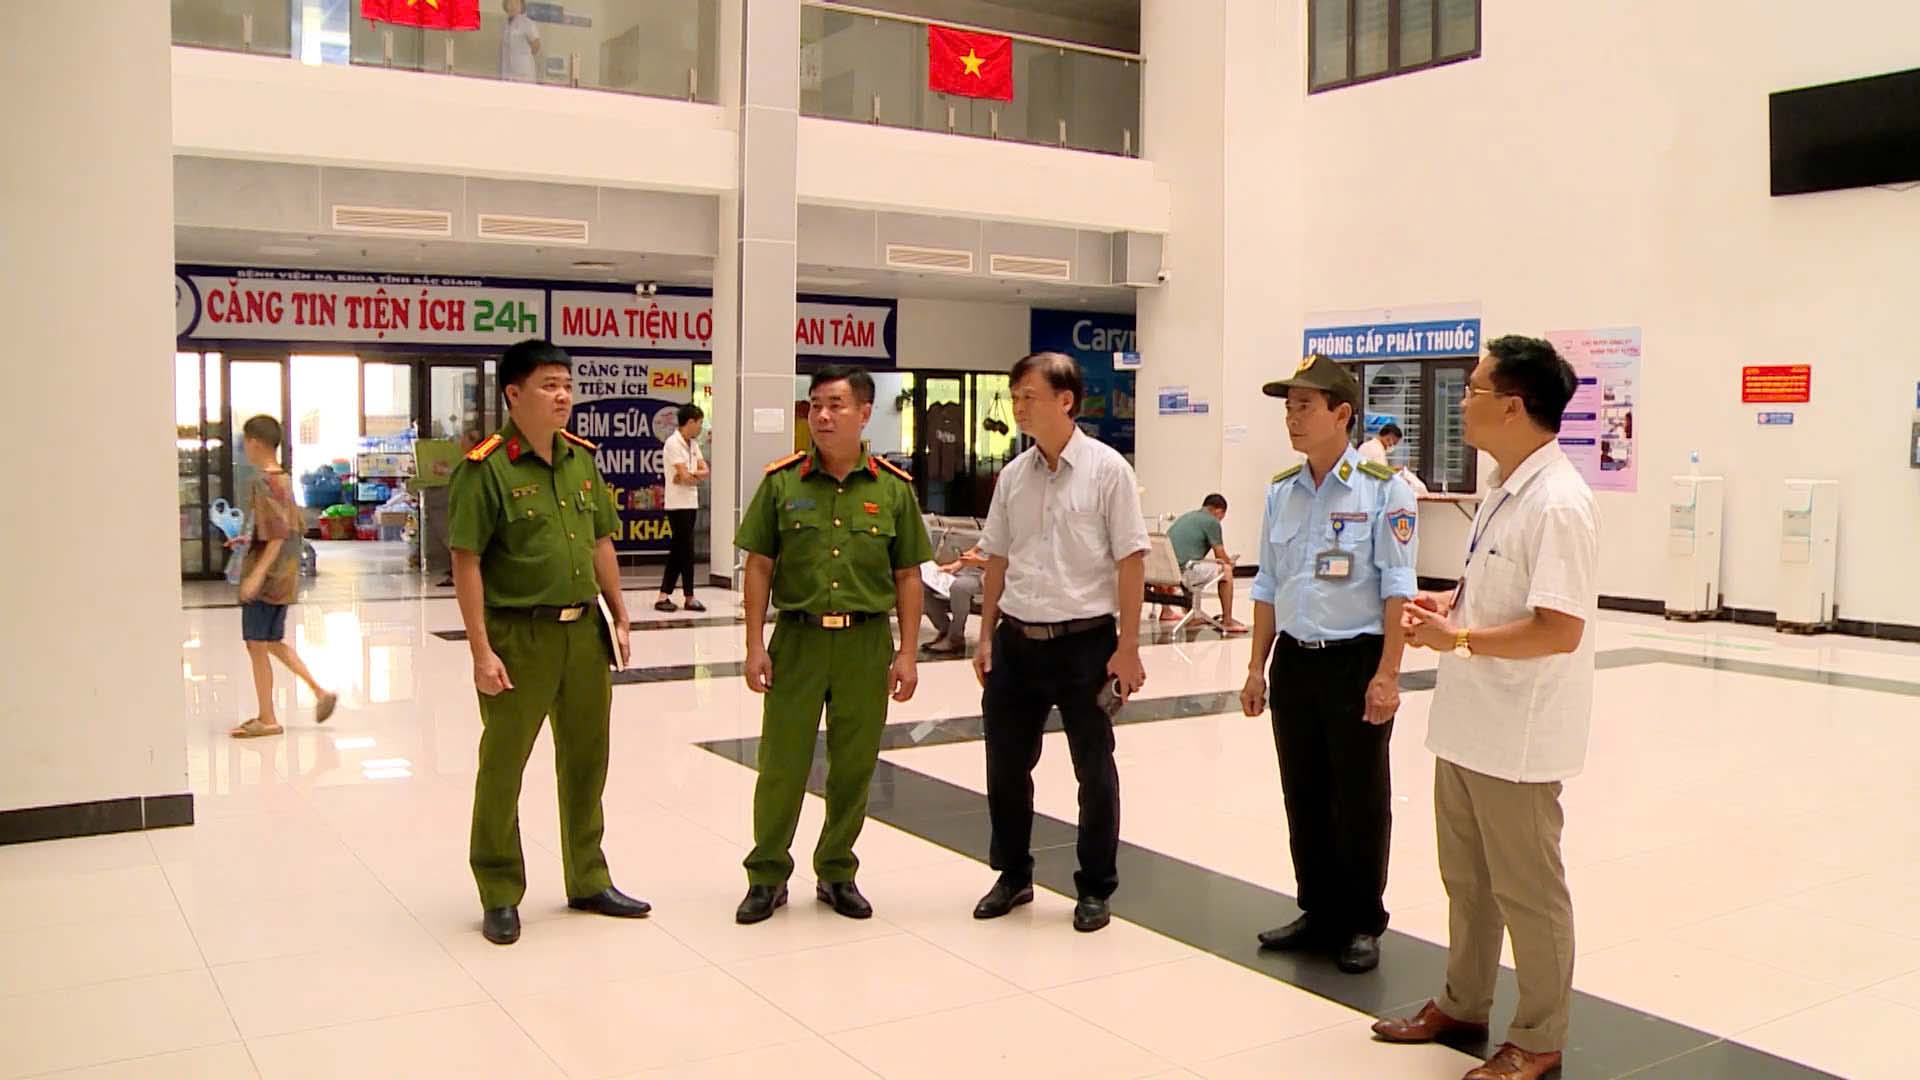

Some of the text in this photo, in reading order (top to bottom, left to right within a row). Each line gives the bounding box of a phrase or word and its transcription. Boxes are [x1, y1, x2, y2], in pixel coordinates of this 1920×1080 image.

[207, 279, 537, 339] CĂNG TIN TIỆN ÍCH 24h
[562, 303, 875, 348] MUA TIỆN LỢ AN TÂM
[1308, 322, 1475, 356] PHÒNG CẤP PHÁT THUỐC
[578, 360, 649, 377] CĂNG TIN
[652, 371, 687, 388] 24h
[579, 378, 649, 399] TIỆN ÍCH
[613, 407, 651, 437] SỮA
[595, 443, 665, 479] ÁNH KẸ
